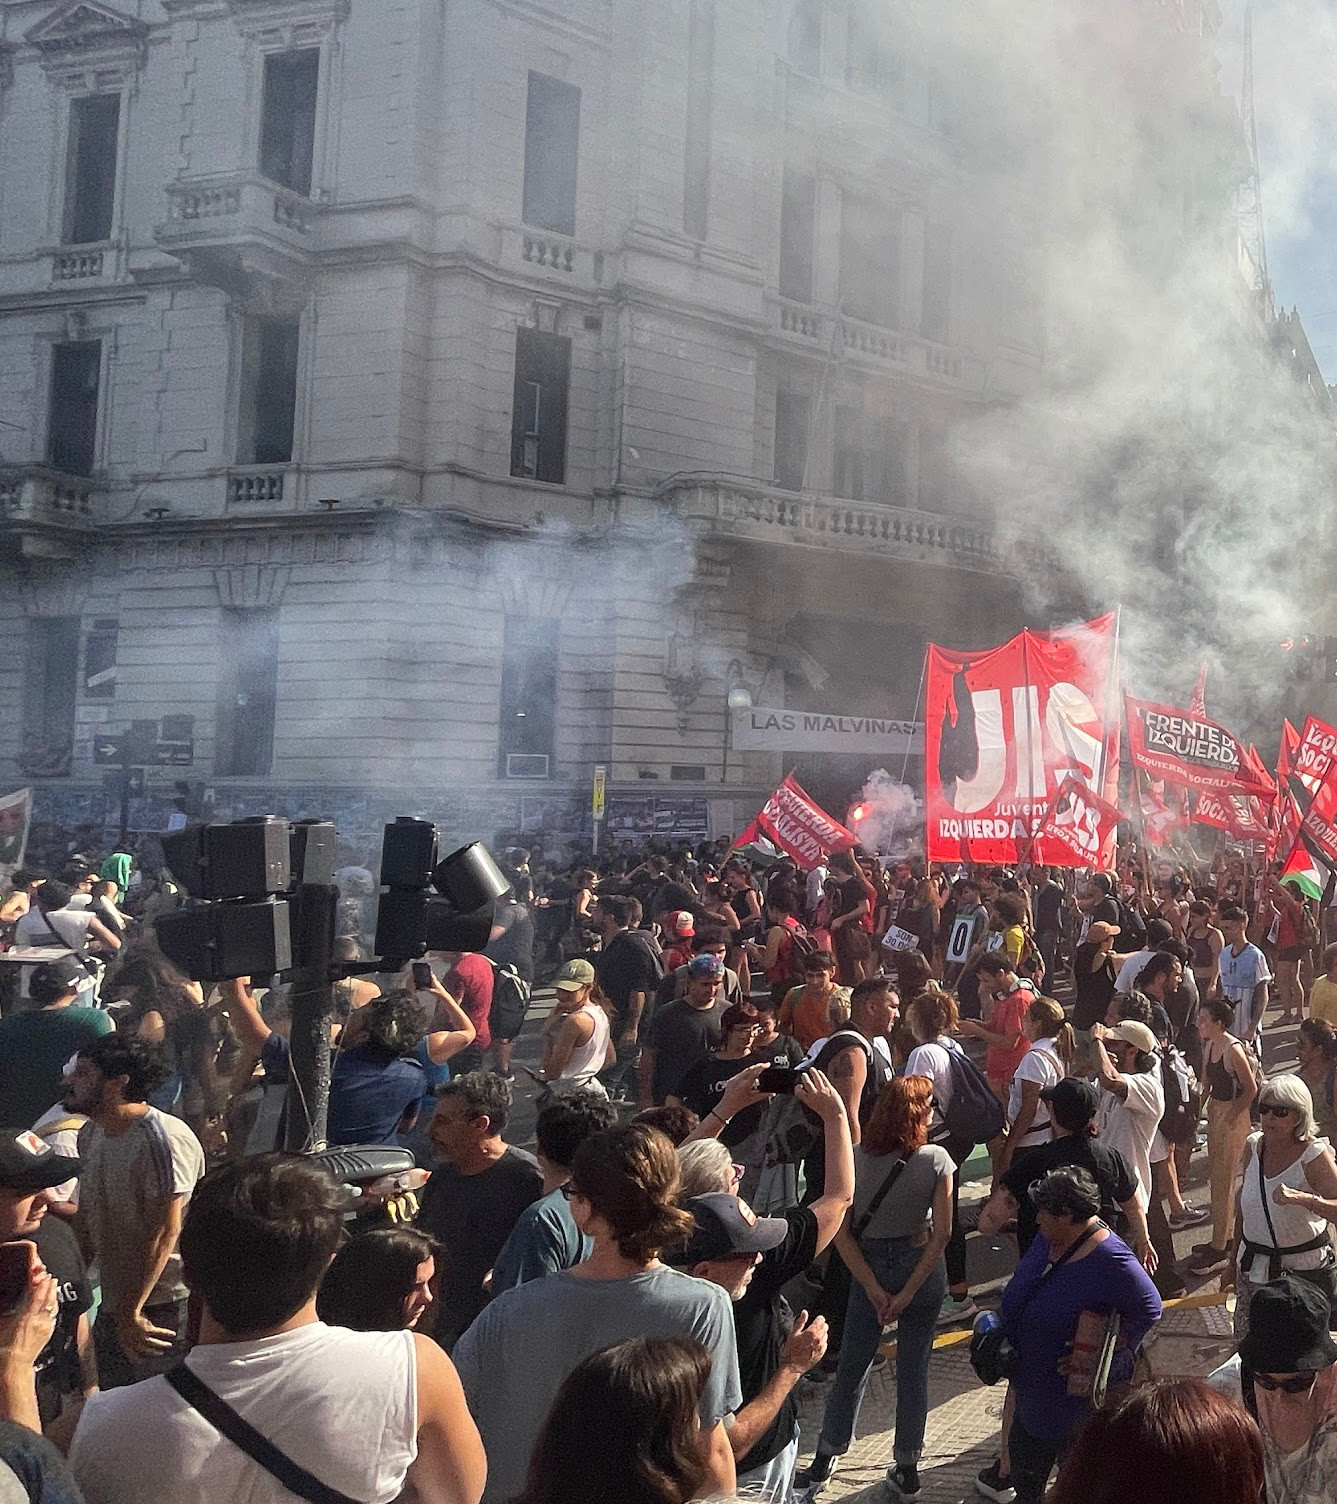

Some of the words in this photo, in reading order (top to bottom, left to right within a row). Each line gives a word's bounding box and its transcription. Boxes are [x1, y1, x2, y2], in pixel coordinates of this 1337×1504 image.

[751, 713, 796, 731] LAS
[803, 715, 917, 735] MALVINAS
[1145, 711, 1220, 745] FRENTE
[994, 802, 1050, 817] Juvent
[940, 818, 1027, 839] IZQUIERDA
